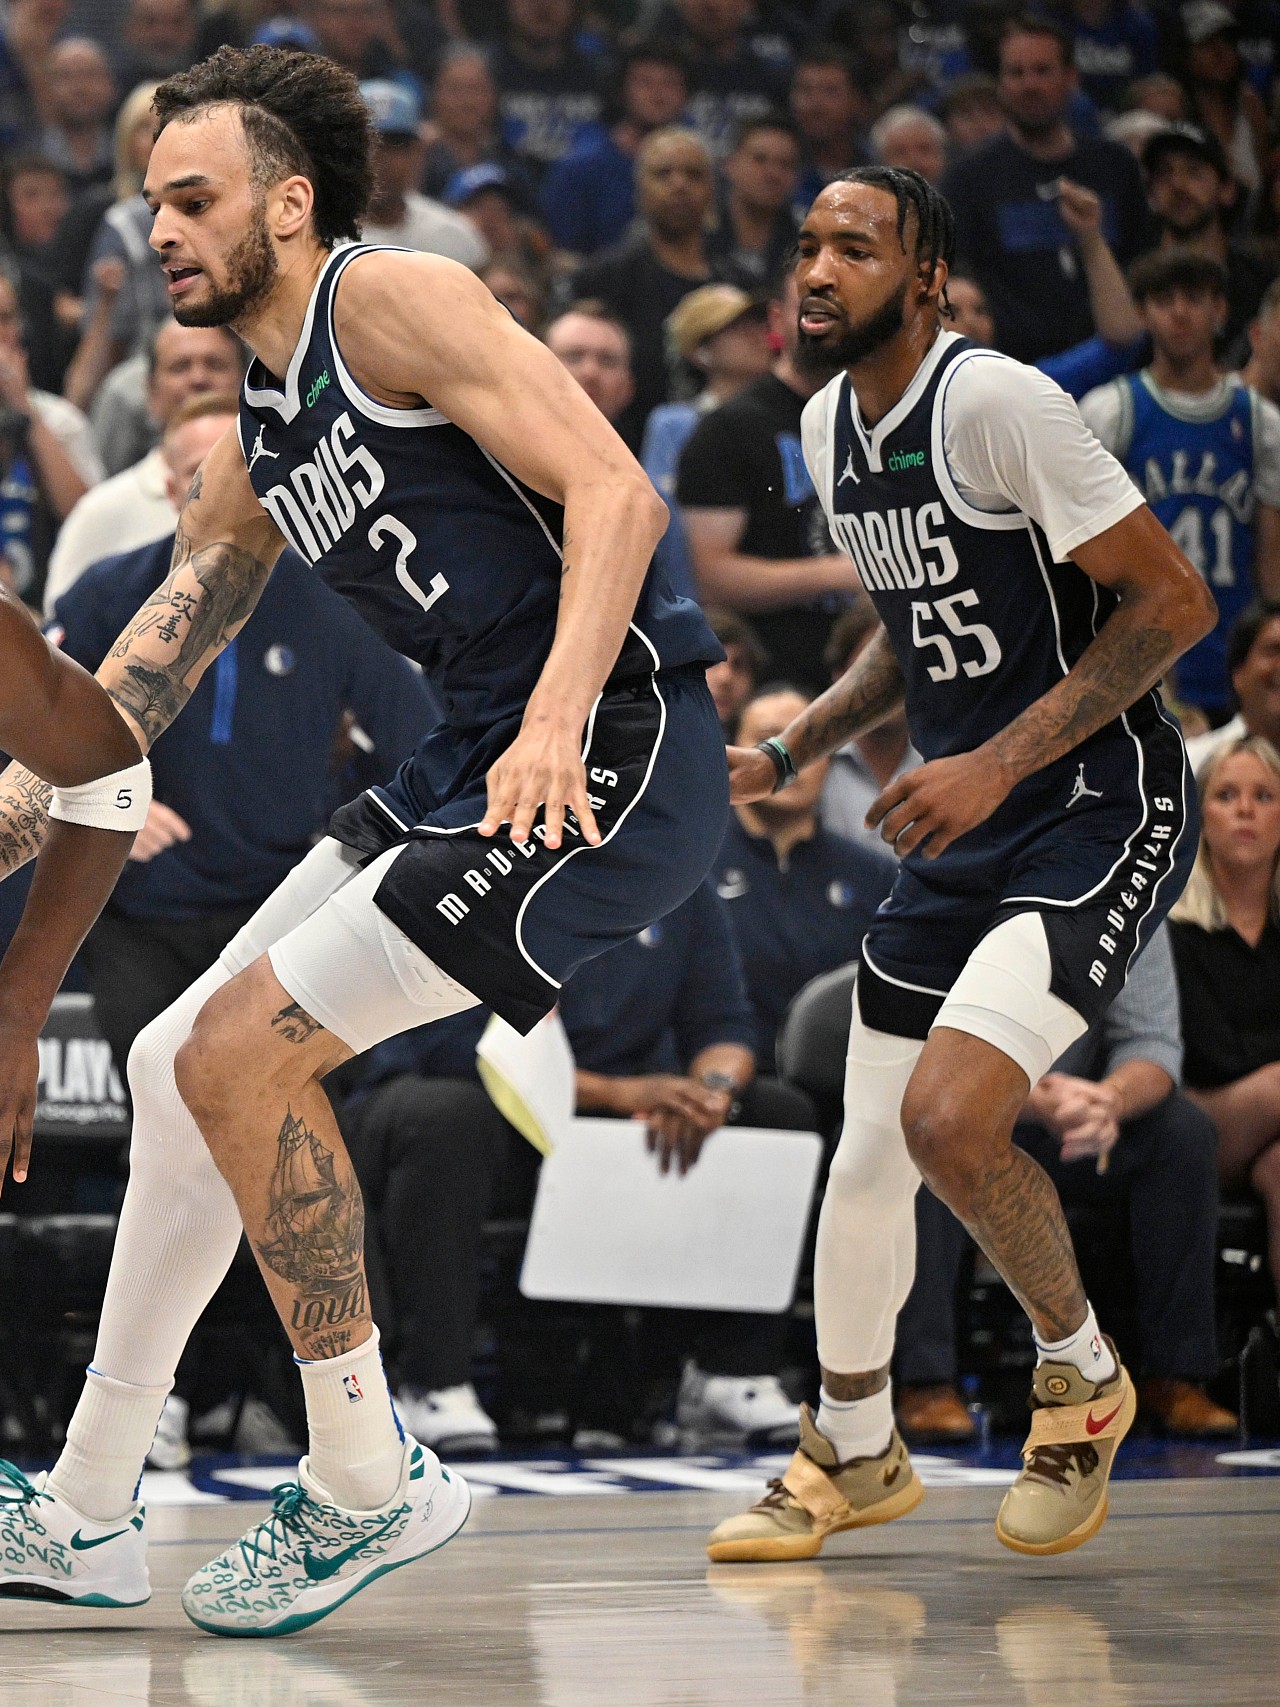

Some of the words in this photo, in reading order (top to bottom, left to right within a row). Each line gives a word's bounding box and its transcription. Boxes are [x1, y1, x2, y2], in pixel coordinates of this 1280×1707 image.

[306, 369, 331, 408] chime
[888, 450, 925, 472] chime
[368, 514, 450, 612] 2
[833, 501, 959, 591] MAVS
[910, 589, 1002, 683] 55
[115, 789, 132, 809] 5
